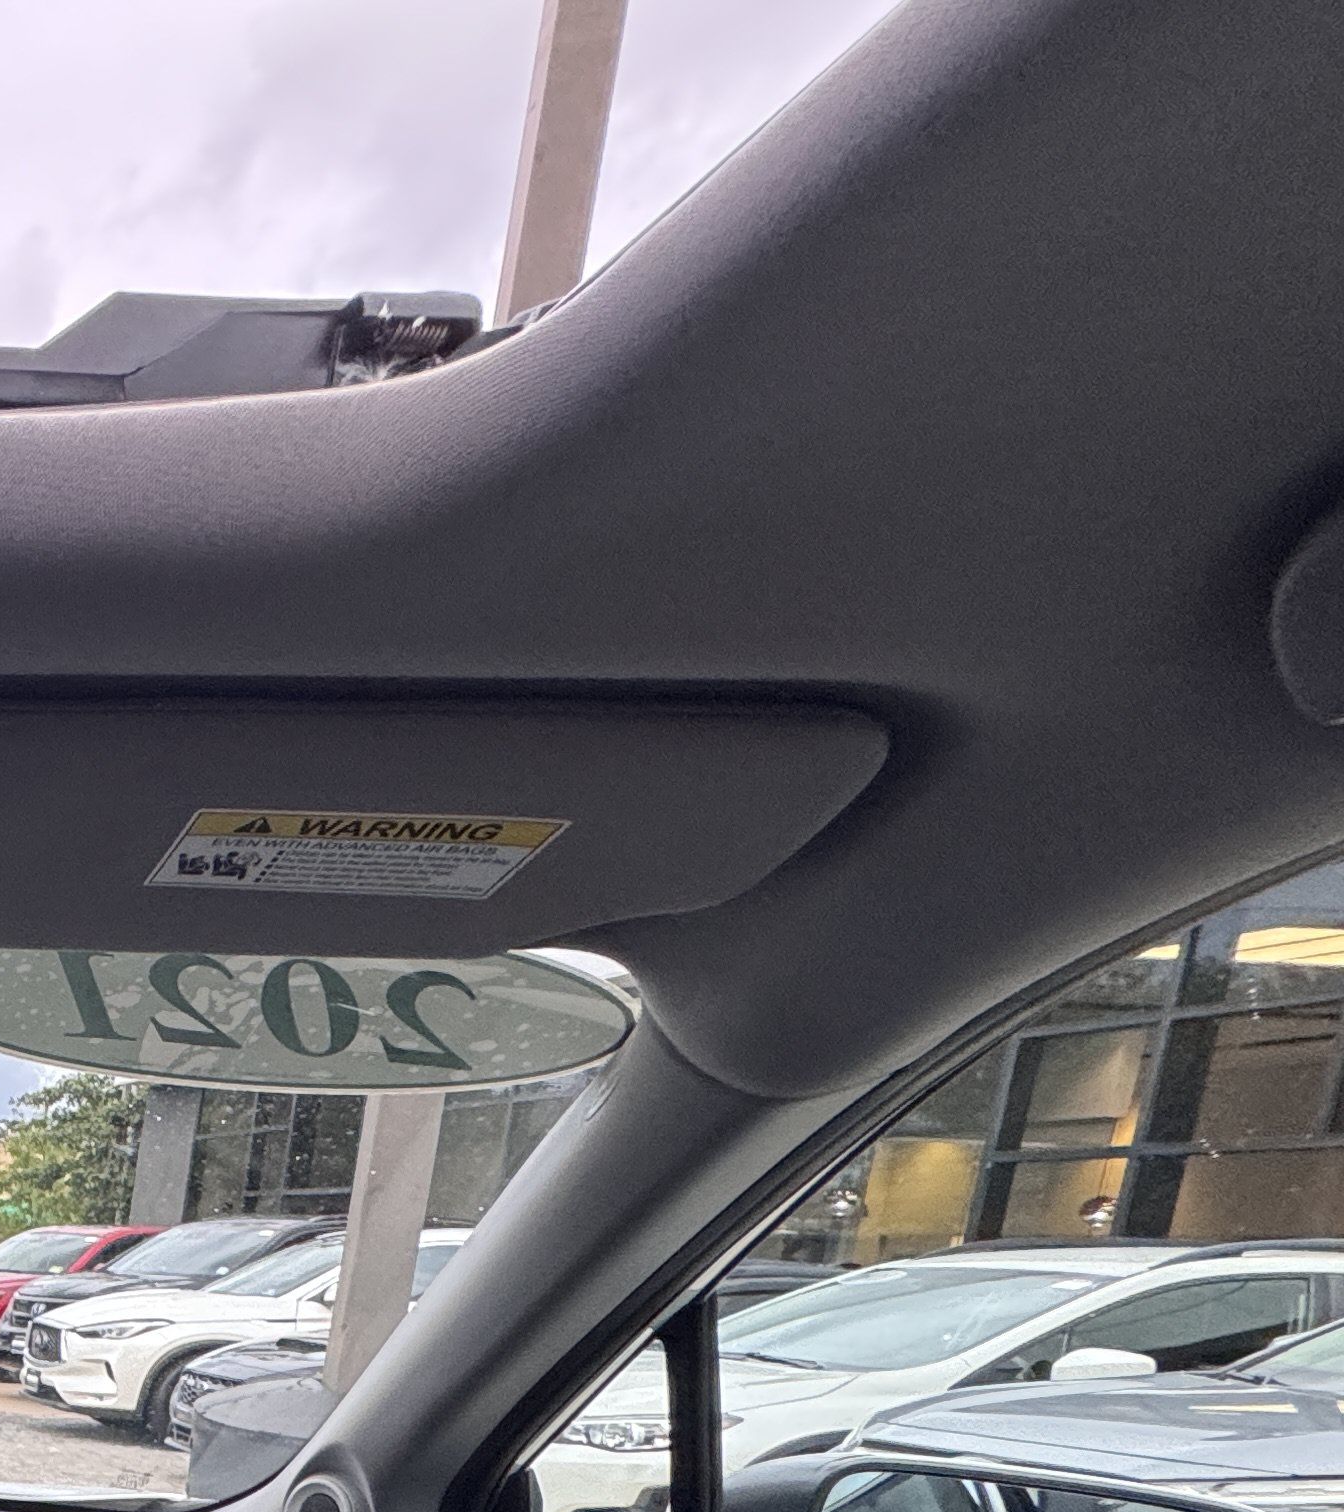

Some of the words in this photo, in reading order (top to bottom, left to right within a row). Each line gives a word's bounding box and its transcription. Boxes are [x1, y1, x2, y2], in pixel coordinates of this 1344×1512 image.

[298, 818, 504, 842] WARNING
[212, 837, 261, 848] EVEN
[264, 838, 310, 850] WITH
[311, 841, 411, 853] ADVANCED
[412, 844, 442, 855] AIR
[446, 845, 497, 857] BAGS
